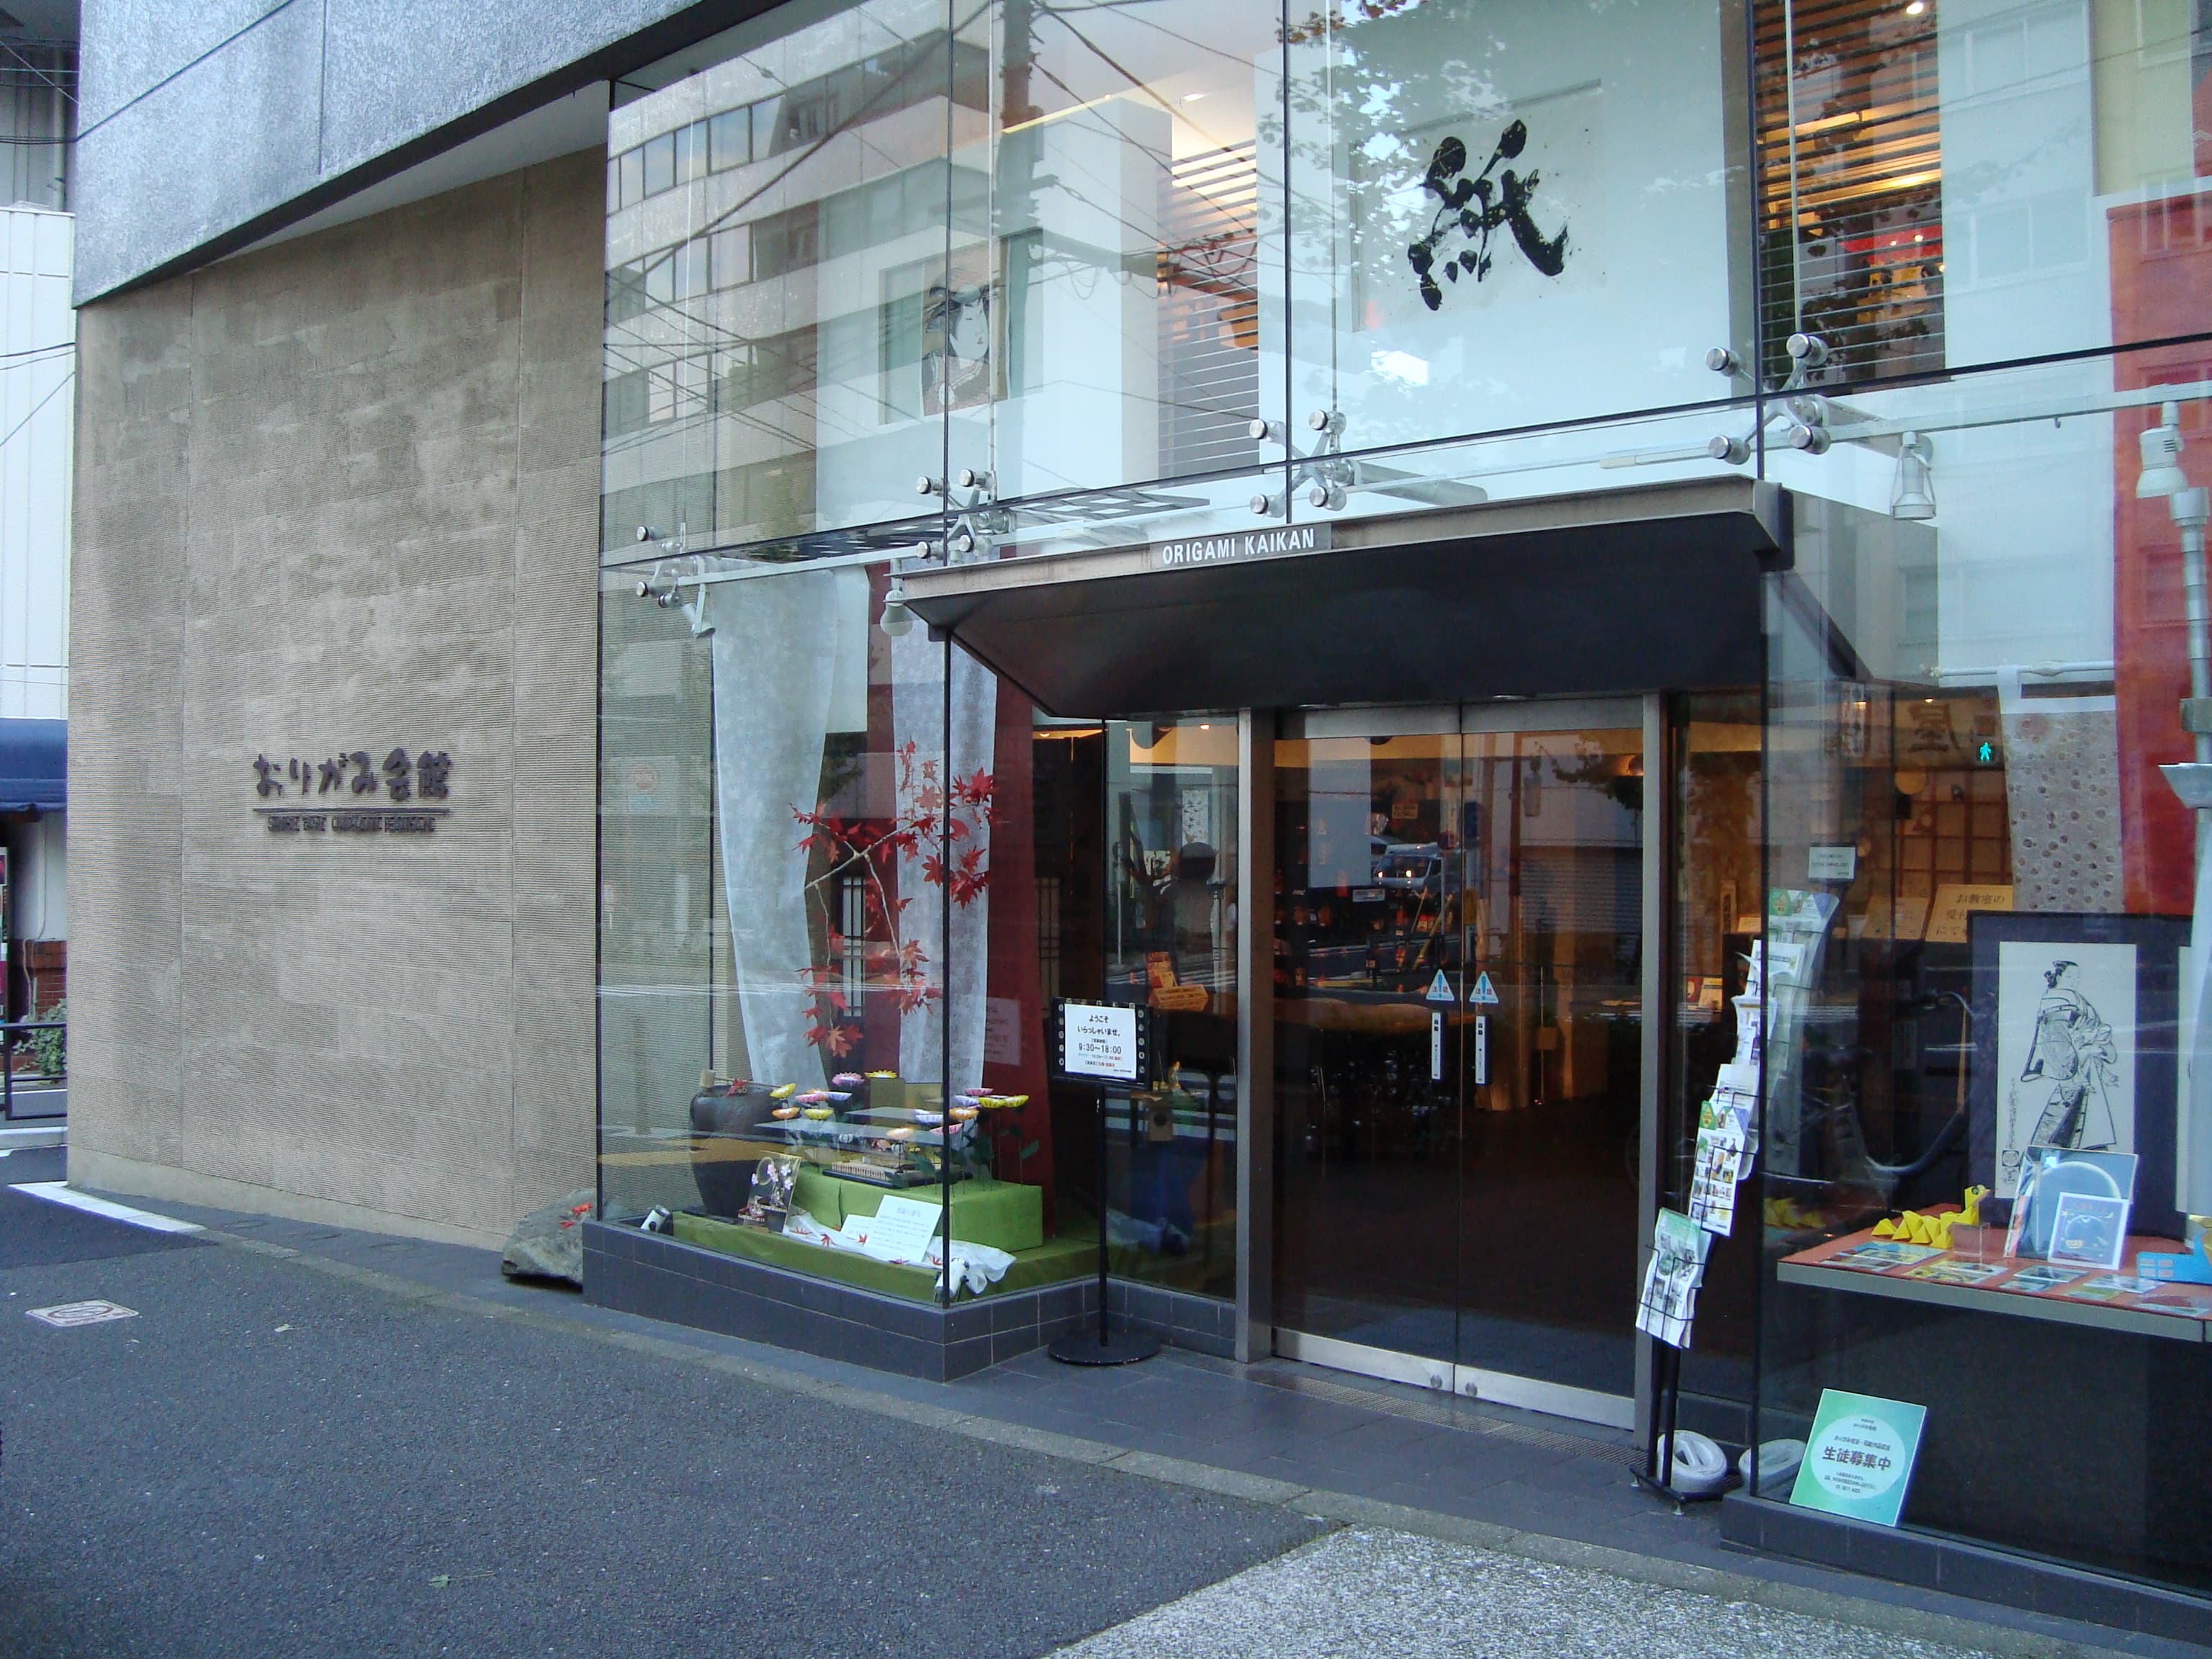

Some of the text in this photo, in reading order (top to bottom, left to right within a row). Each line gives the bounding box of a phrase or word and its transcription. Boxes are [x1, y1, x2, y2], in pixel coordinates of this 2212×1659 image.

[1162, 529, 1315, 565] ORIGAMI KAIKAN
[1089, 1014, 1109, 1023] ようこそ
[1822, 1446, 1892, 1471] 生徒募集中
